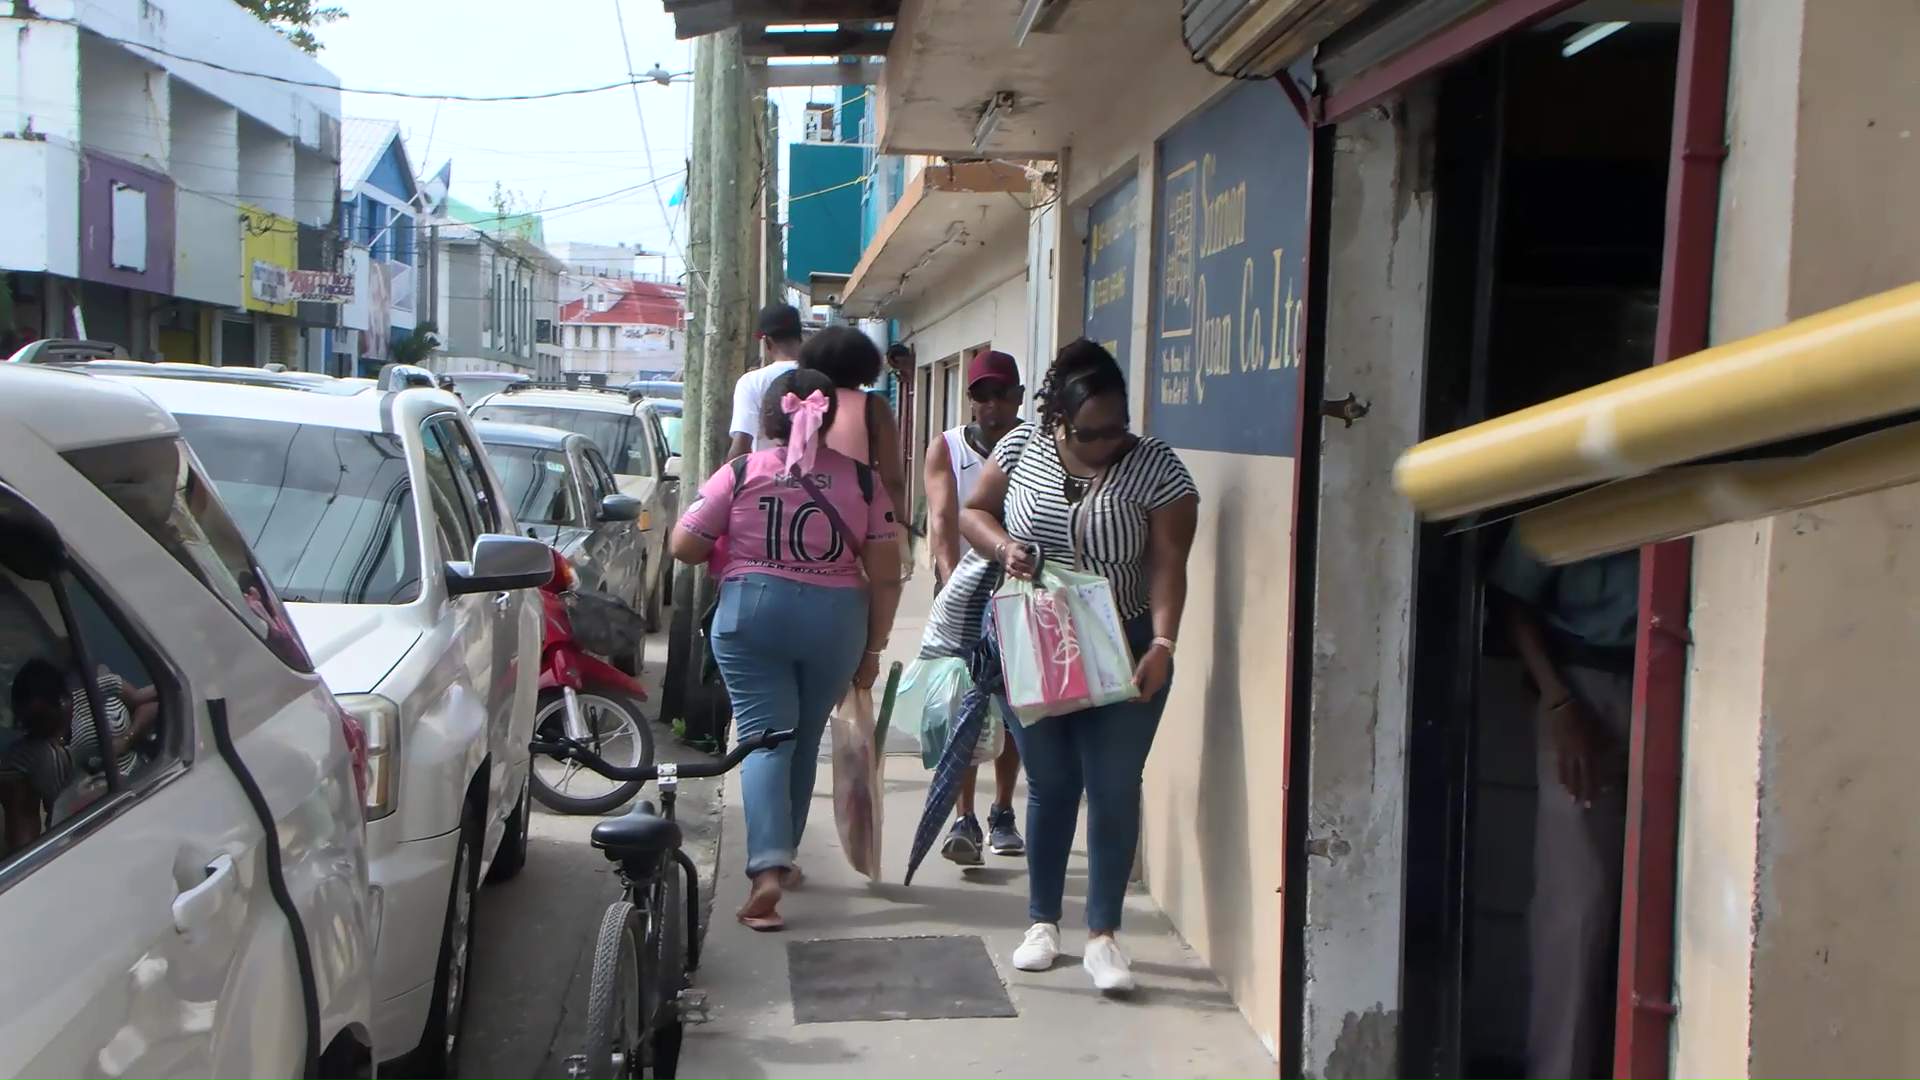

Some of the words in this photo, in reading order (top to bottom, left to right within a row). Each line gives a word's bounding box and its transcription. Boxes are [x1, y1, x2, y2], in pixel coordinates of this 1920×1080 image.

[1201, 153, 1245, 258] Simon
[1195, 274, 1231, 404] Quan
[758, 496, 844, 562] 10
